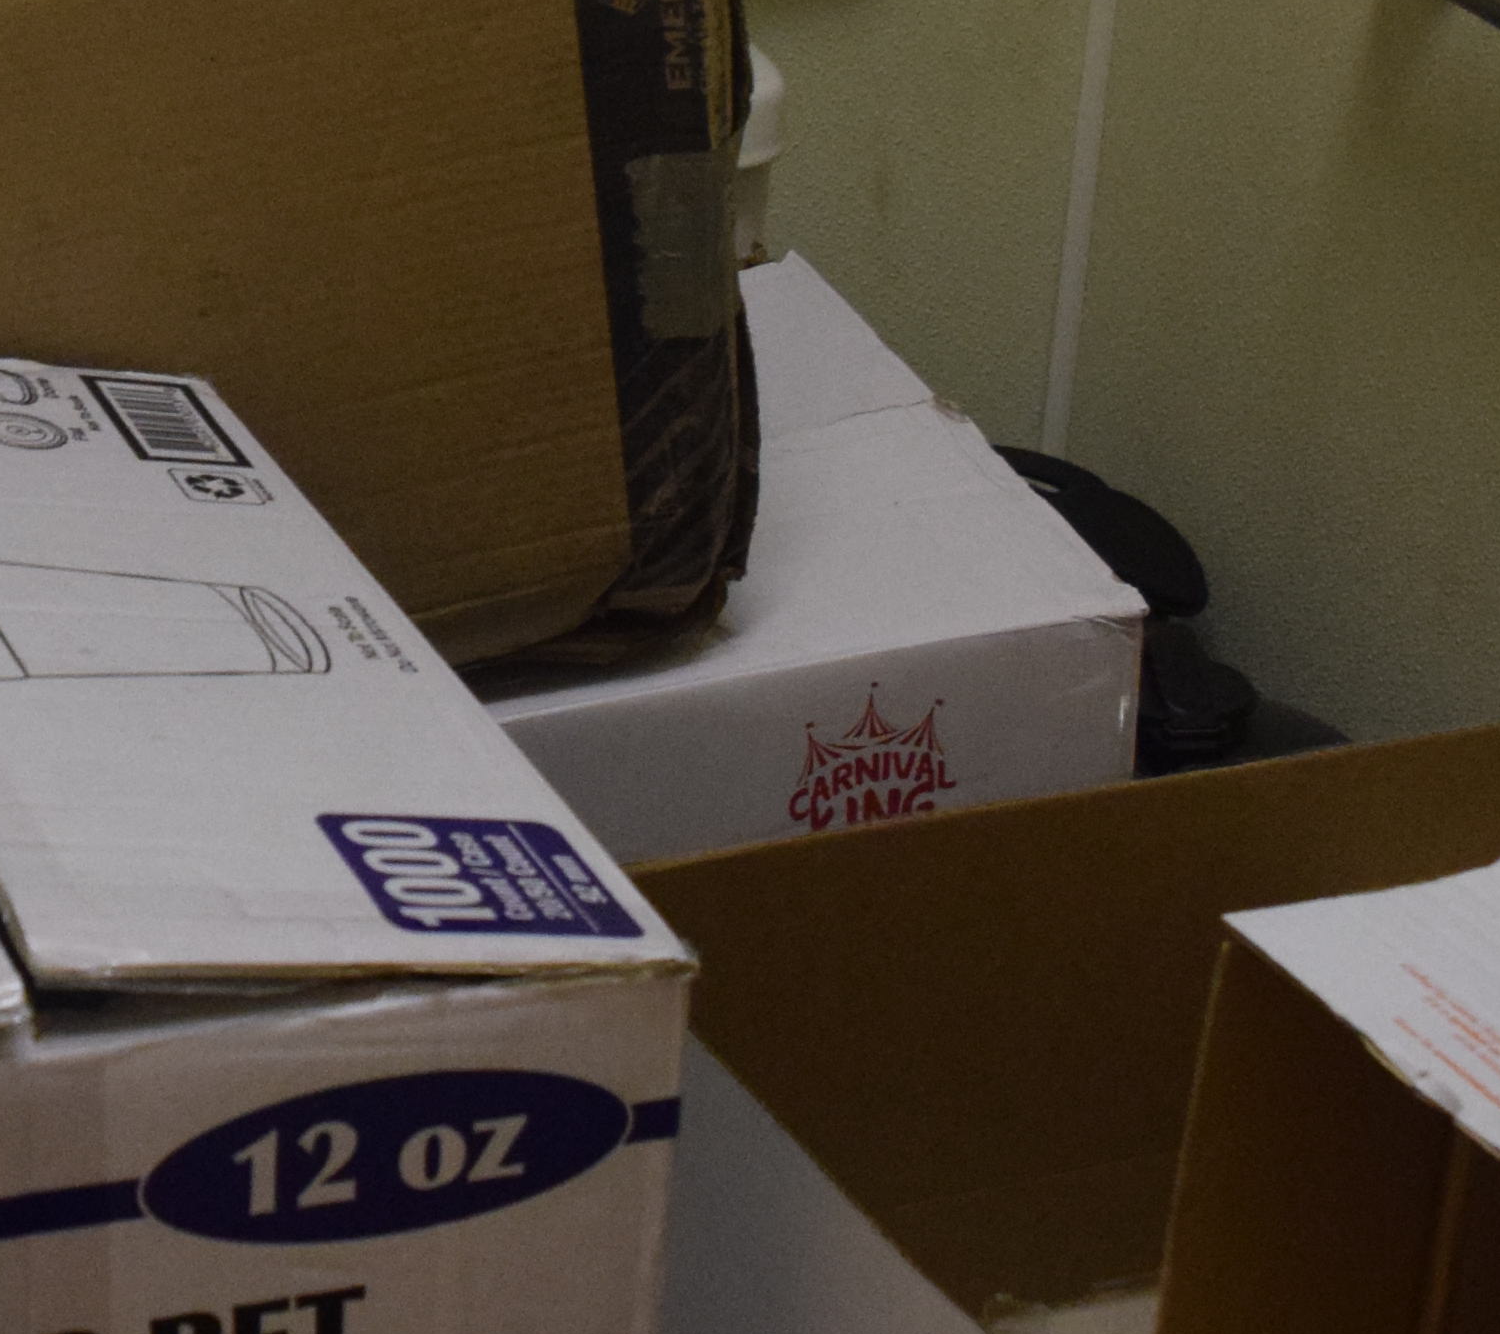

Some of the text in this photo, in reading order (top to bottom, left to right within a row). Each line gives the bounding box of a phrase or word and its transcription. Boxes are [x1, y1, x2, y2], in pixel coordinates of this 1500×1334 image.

[789, 751, 957, 822] CARNIVAL
[340, 819, 498, 928] 1000
[231, 1119, 360, 1220] 12
